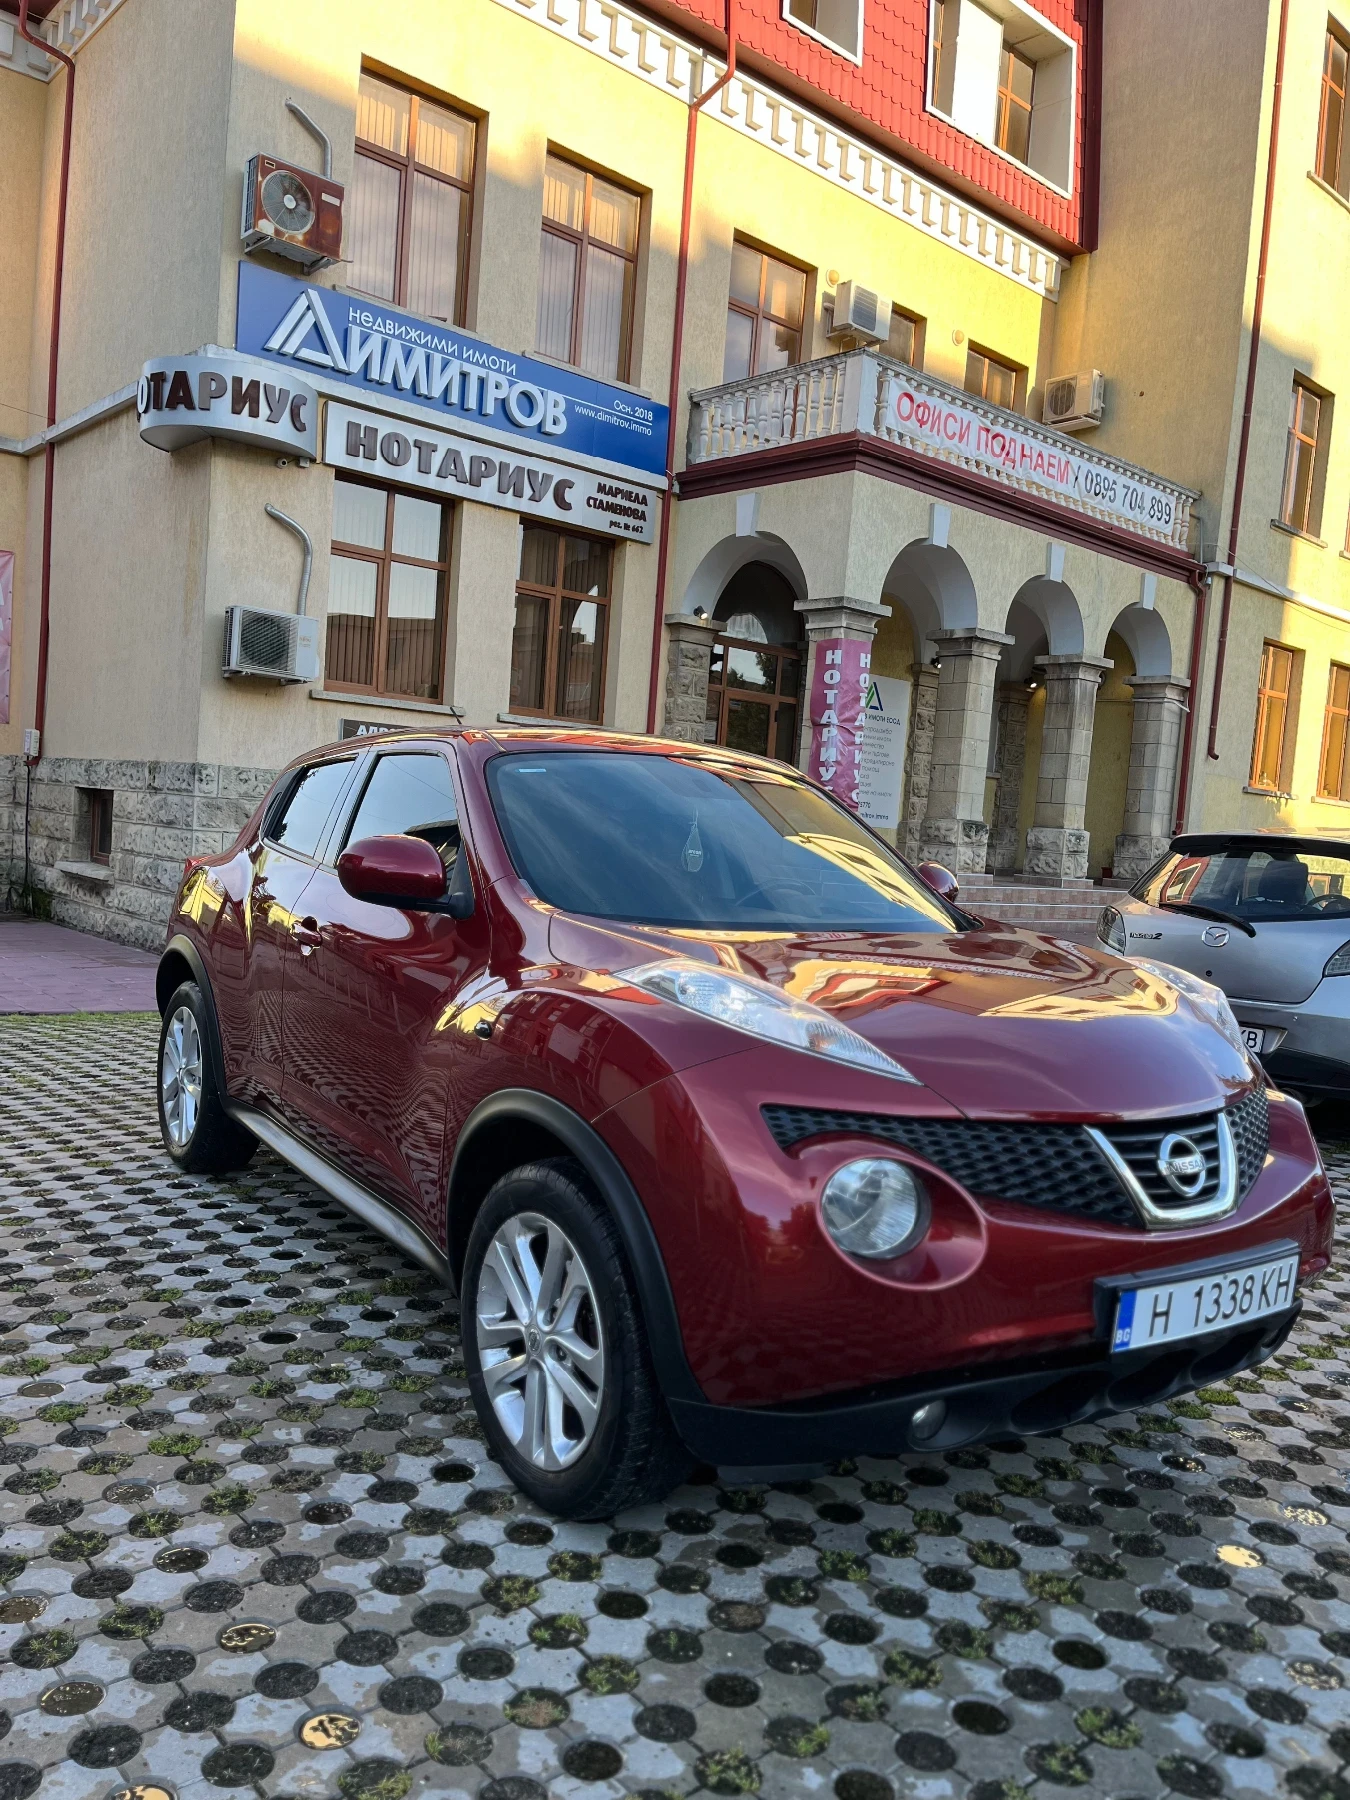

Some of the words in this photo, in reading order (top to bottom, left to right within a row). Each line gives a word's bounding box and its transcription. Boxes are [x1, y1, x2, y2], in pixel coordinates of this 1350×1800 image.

[137, 370, 308, 433] ОТАРИУС
[613, 400, 634, 415] Осн.
[634, 406, 653, 421] 2018
[574, 404, 652, 436] www.dimitrov.immo
[346, 420, 576, 511] НОТАРИУС
[896, 391, 971, 447] ОФИСИ
[976, 425, 1017, 471] ПОД
[1020, 443, 1070, 485] НАЕМ
[1085, 469, 1118, 504] 0895
[1122, 484, 1146, 515] 704
[1148, 496, 1172, 525] 899
[586, 496, 647, 522] СТАМЕНОВА
[596, 482, 649, 507] МАРИЕЛА
[818, 649, 843, 791] НОТАРИУ
[1165, 1158, 1205, 1174] NISSAN
[1115, 1328, 1131, 1344] BG
